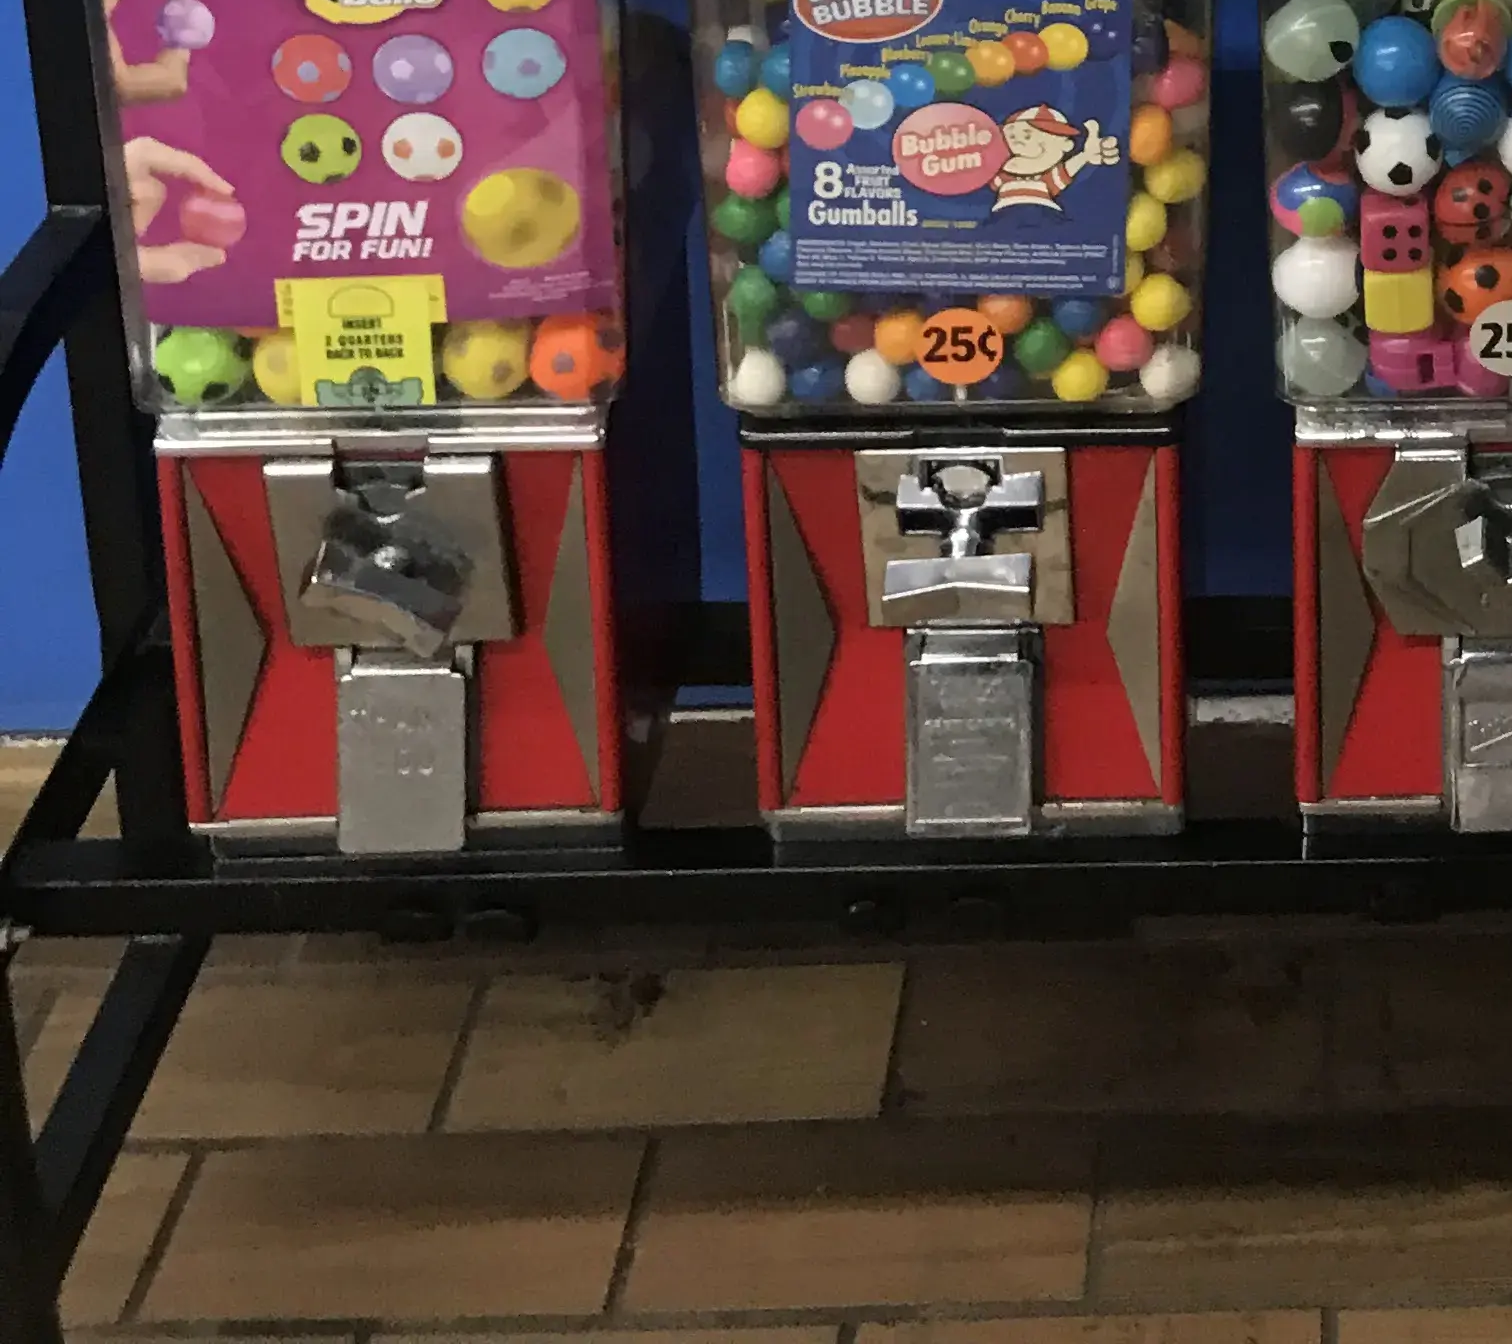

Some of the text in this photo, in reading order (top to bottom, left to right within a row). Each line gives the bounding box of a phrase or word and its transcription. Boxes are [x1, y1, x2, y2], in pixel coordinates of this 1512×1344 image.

[900, 123, 993, 157] Bubble
[921, 149, 983, 178] Gum
[813, 161, 844, 200] 8
[844, 186, 903, 199] FLAVORS
[855, 175, 891, 187] FRUIT
[295, 200, 428, 239] SPIN
[807, 199, 919, 227] Gumballs
[293, 237, 433, 261] FOR FUN!
[342, 317, 382, 329] INSERT
[338, 333, 404, 346] QUARTERS
[358, 347, 373, 358] TO
[923, 324, 998, 362] 25¢
